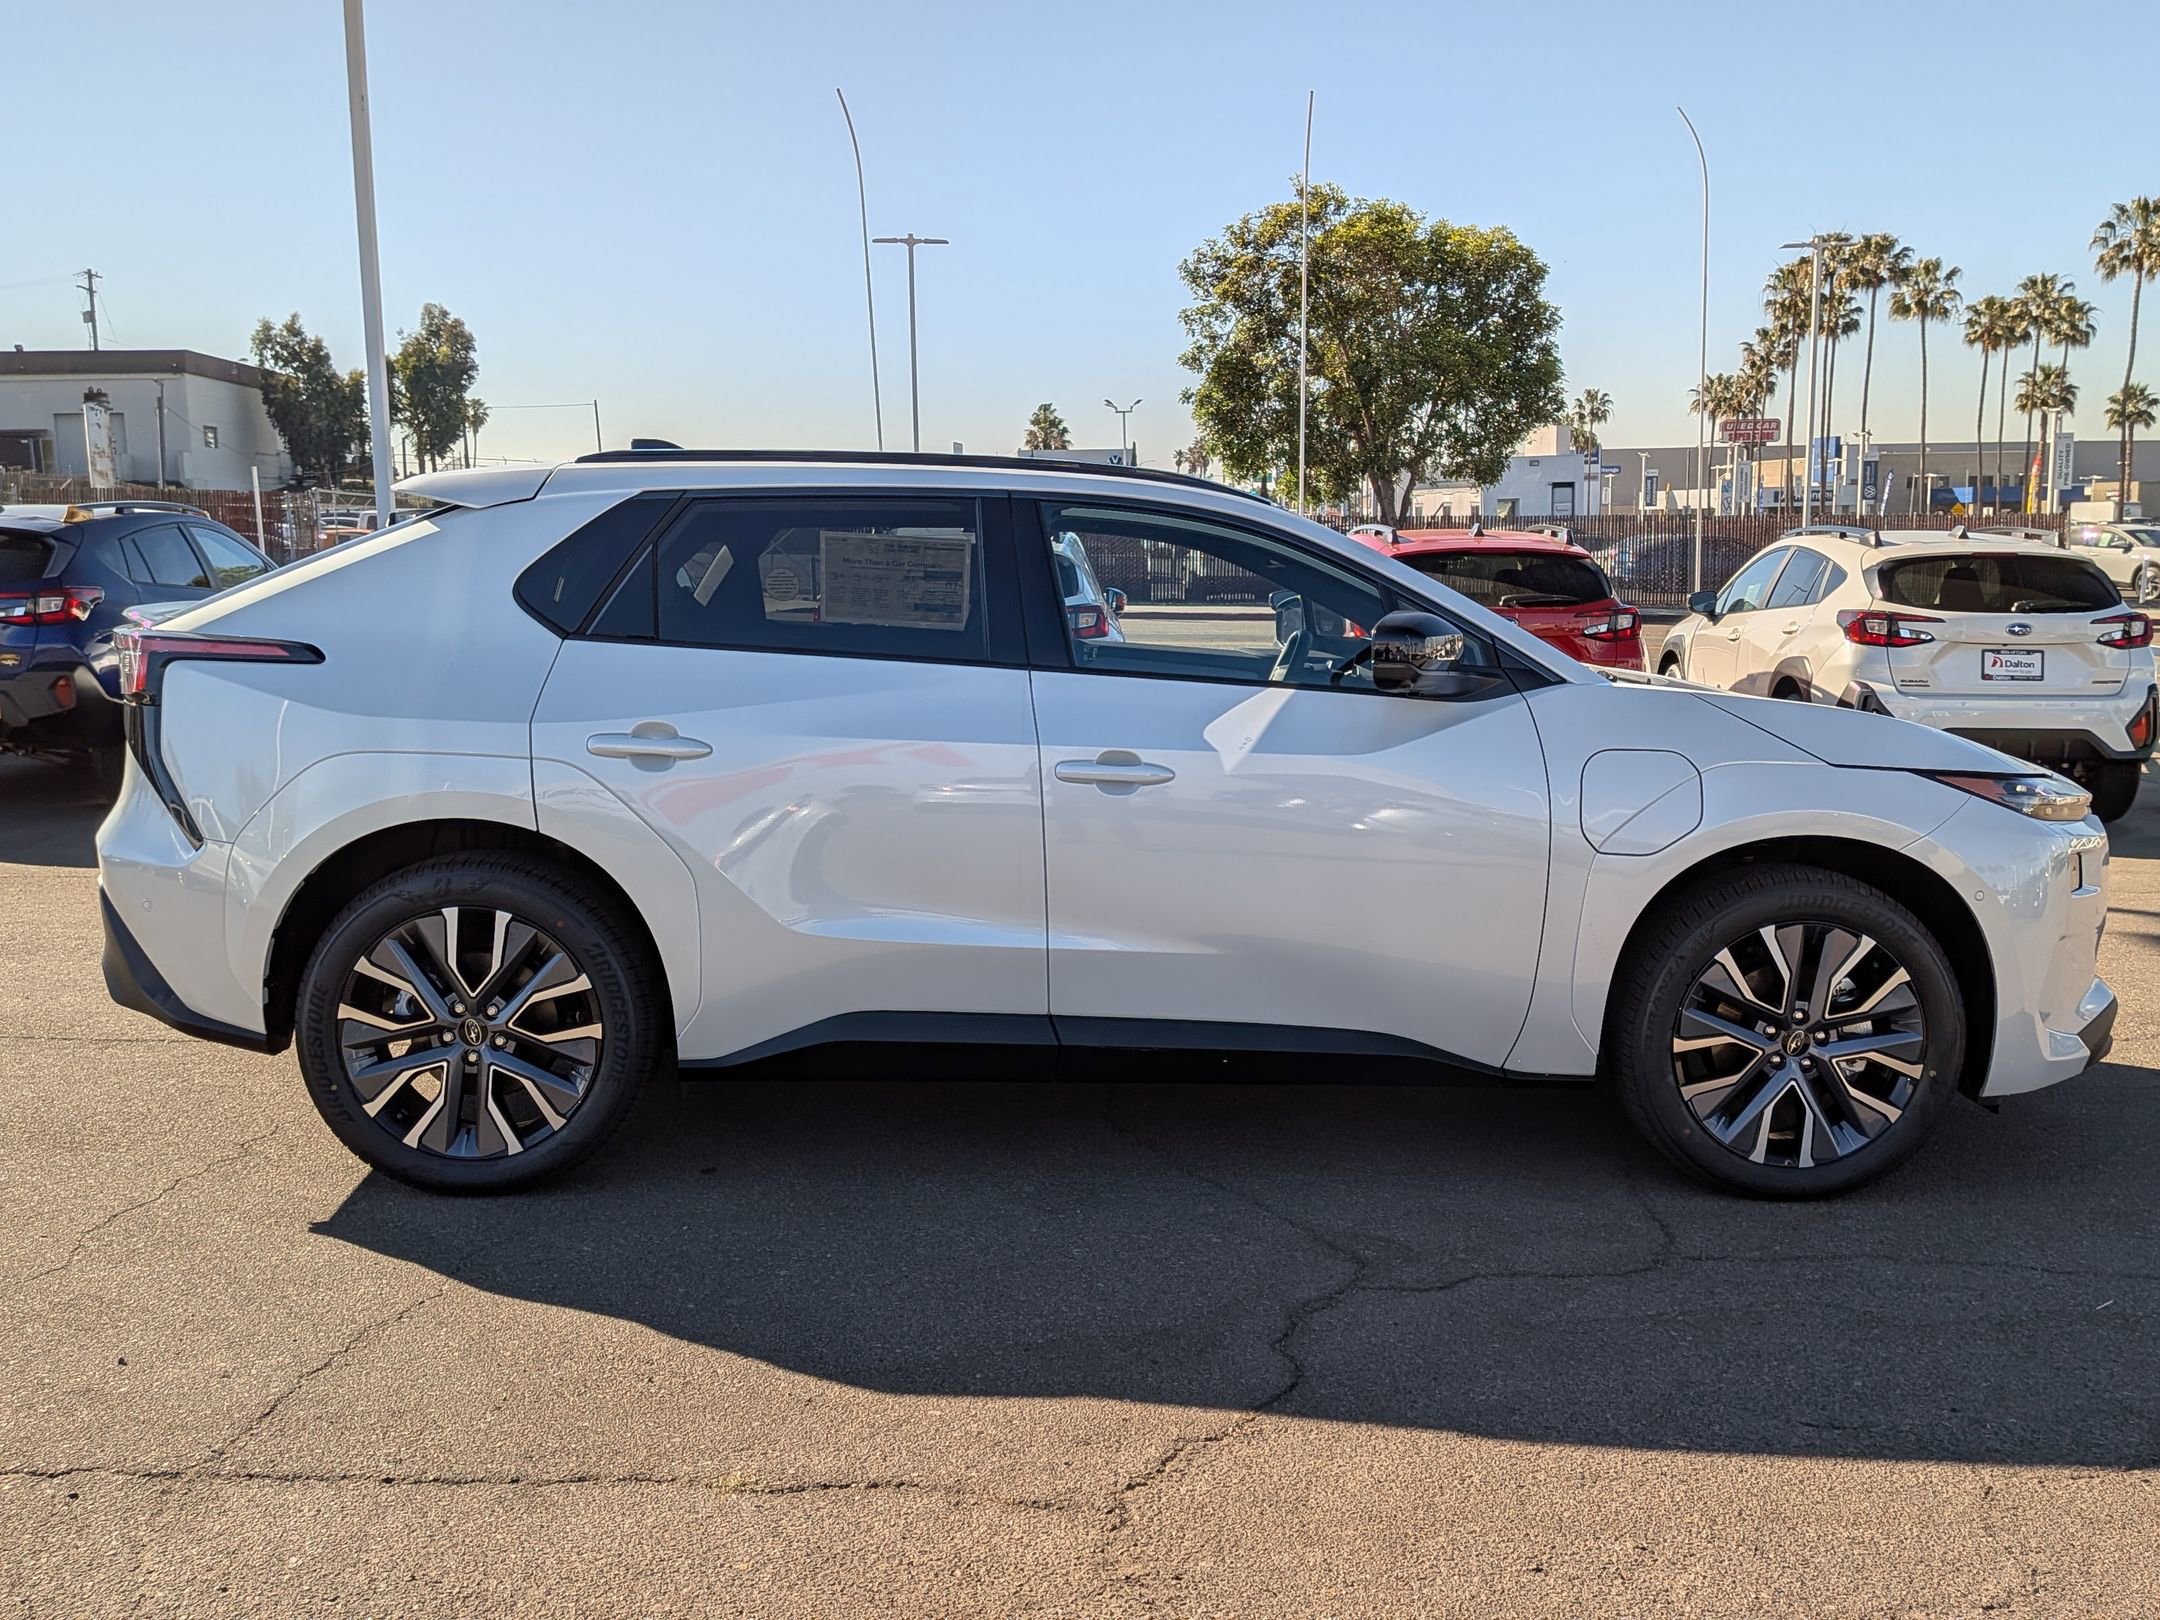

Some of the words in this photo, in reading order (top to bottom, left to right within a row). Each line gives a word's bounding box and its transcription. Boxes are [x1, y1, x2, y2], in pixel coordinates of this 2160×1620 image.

[1756, 422, 1778, 430] CAR
[1728, 432, 1752, 441] SPER
[2063, 443, 2071, 486] PRE-OWNED
[842, 557, 863, 566] More
[864, 558, 884, 567] Than
[907, 561, 943, 570] Company
[2004, 659, 2035, 669] Dalton
[583, 941, 631, 1089] BRIDGESTONE
[305, 983, 356, 1127] BRIDGESTONE
